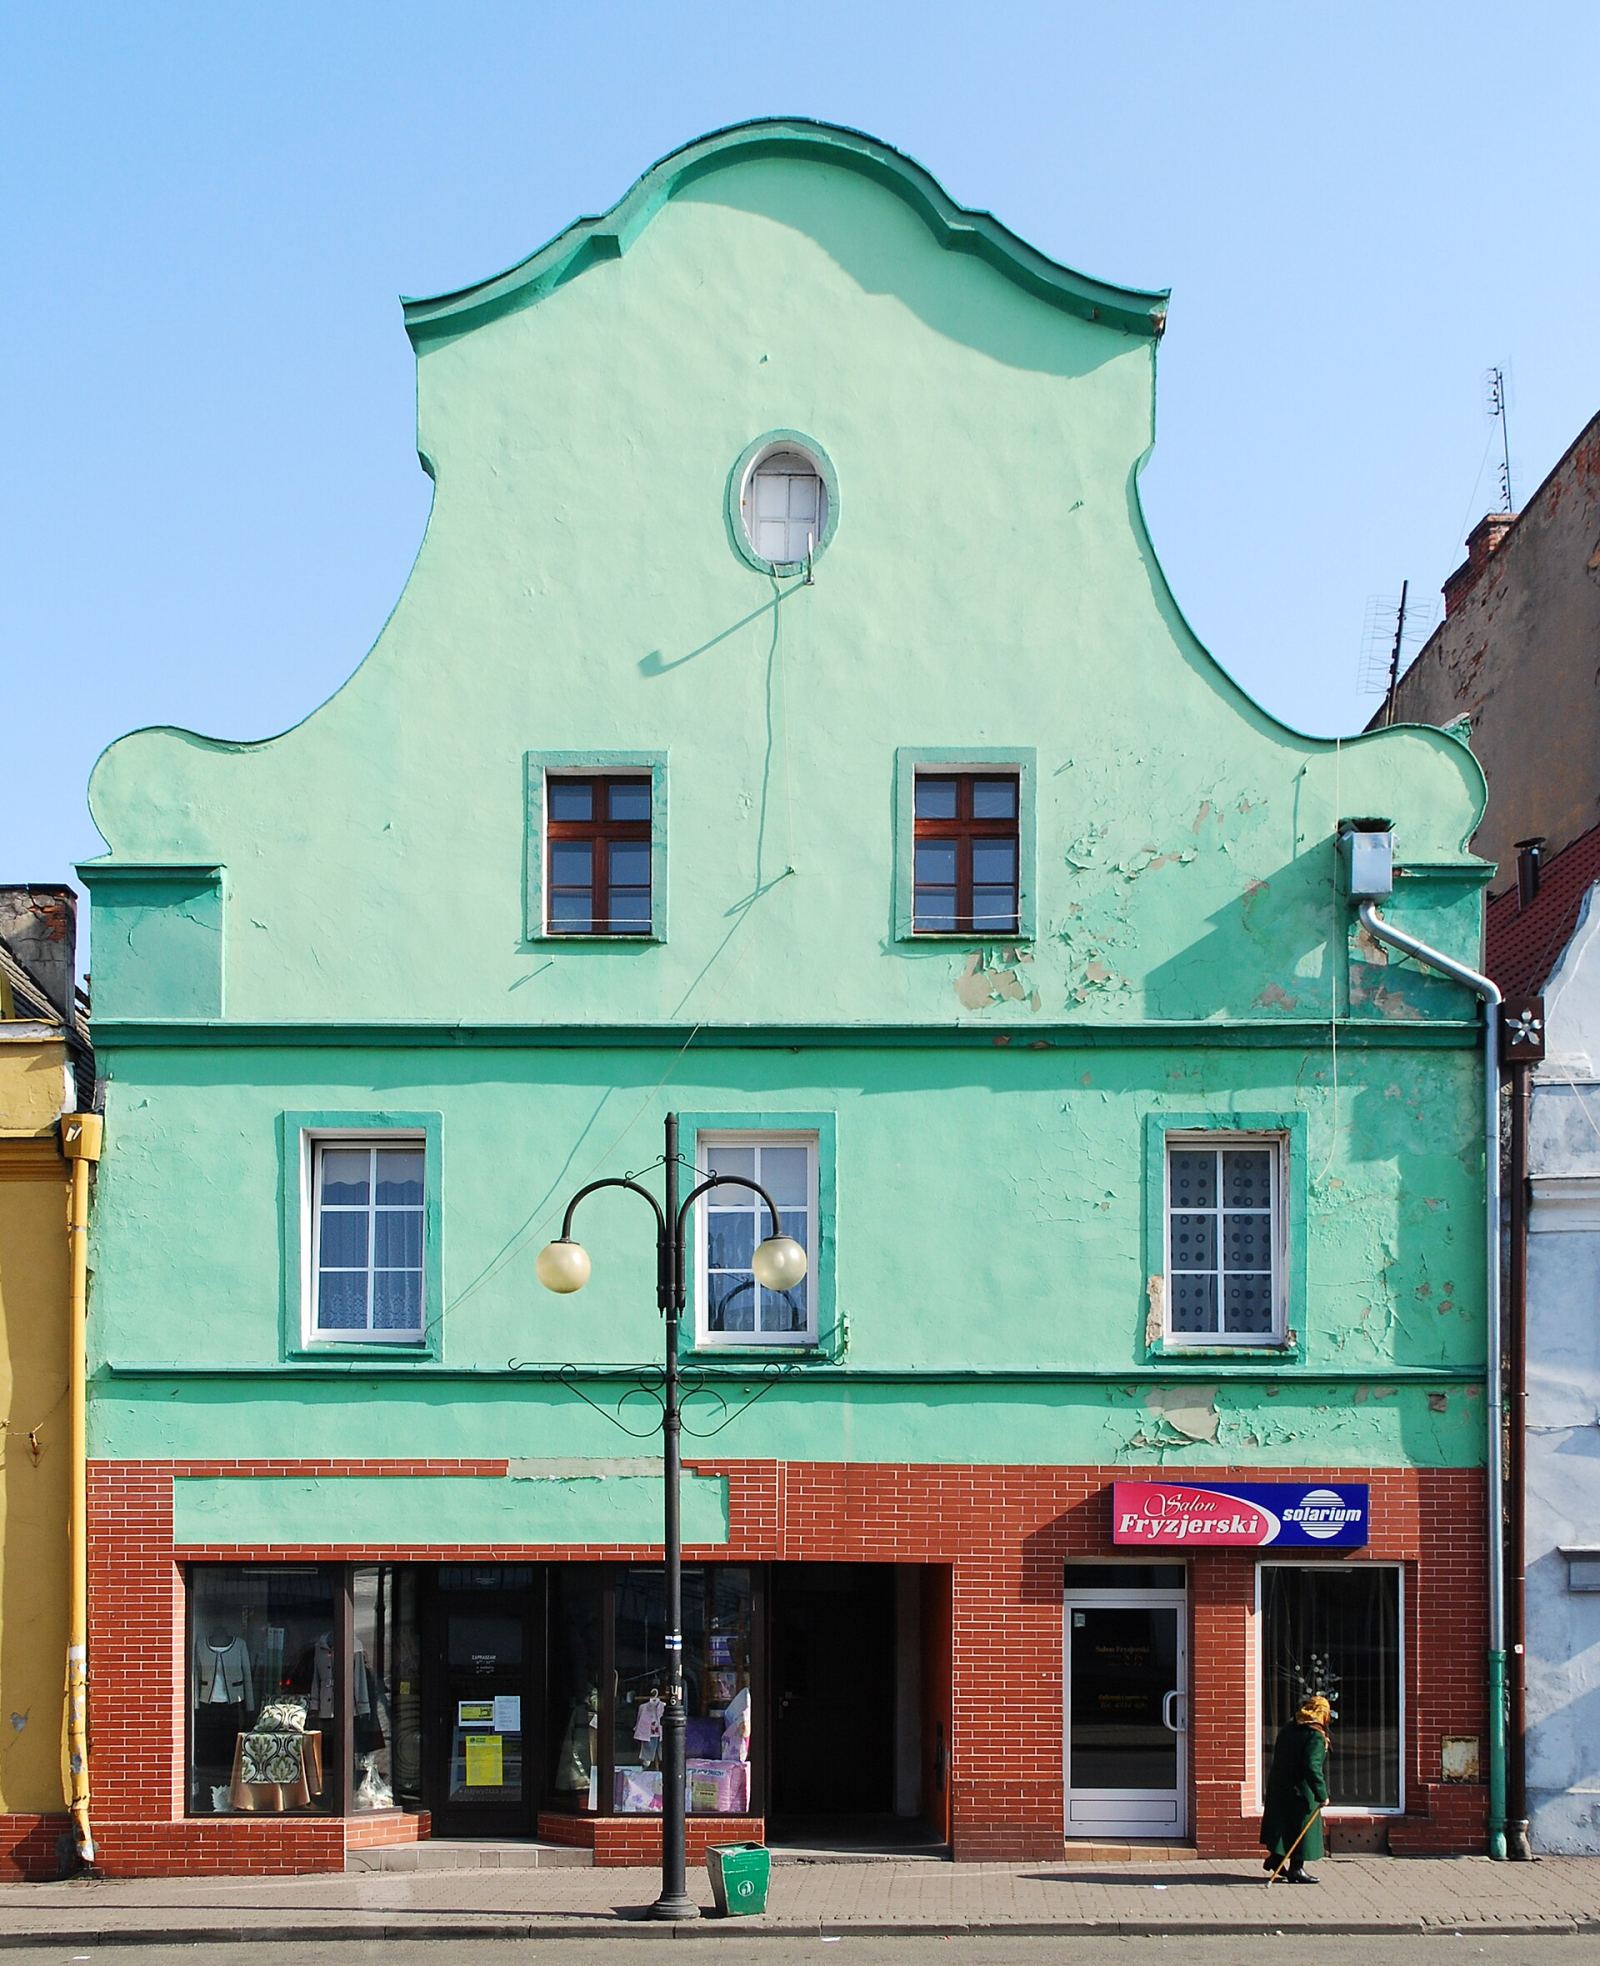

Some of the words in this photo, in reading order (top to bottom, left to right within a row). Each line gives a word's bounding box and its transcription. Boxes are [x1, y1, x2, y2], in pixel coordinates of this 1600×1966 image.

[1144, 1493, 1217, 1517] Salon
[1282, 1506, 1362, 1522] solarium
[1118, 1513, 1260, 1539] Fryzjerski
